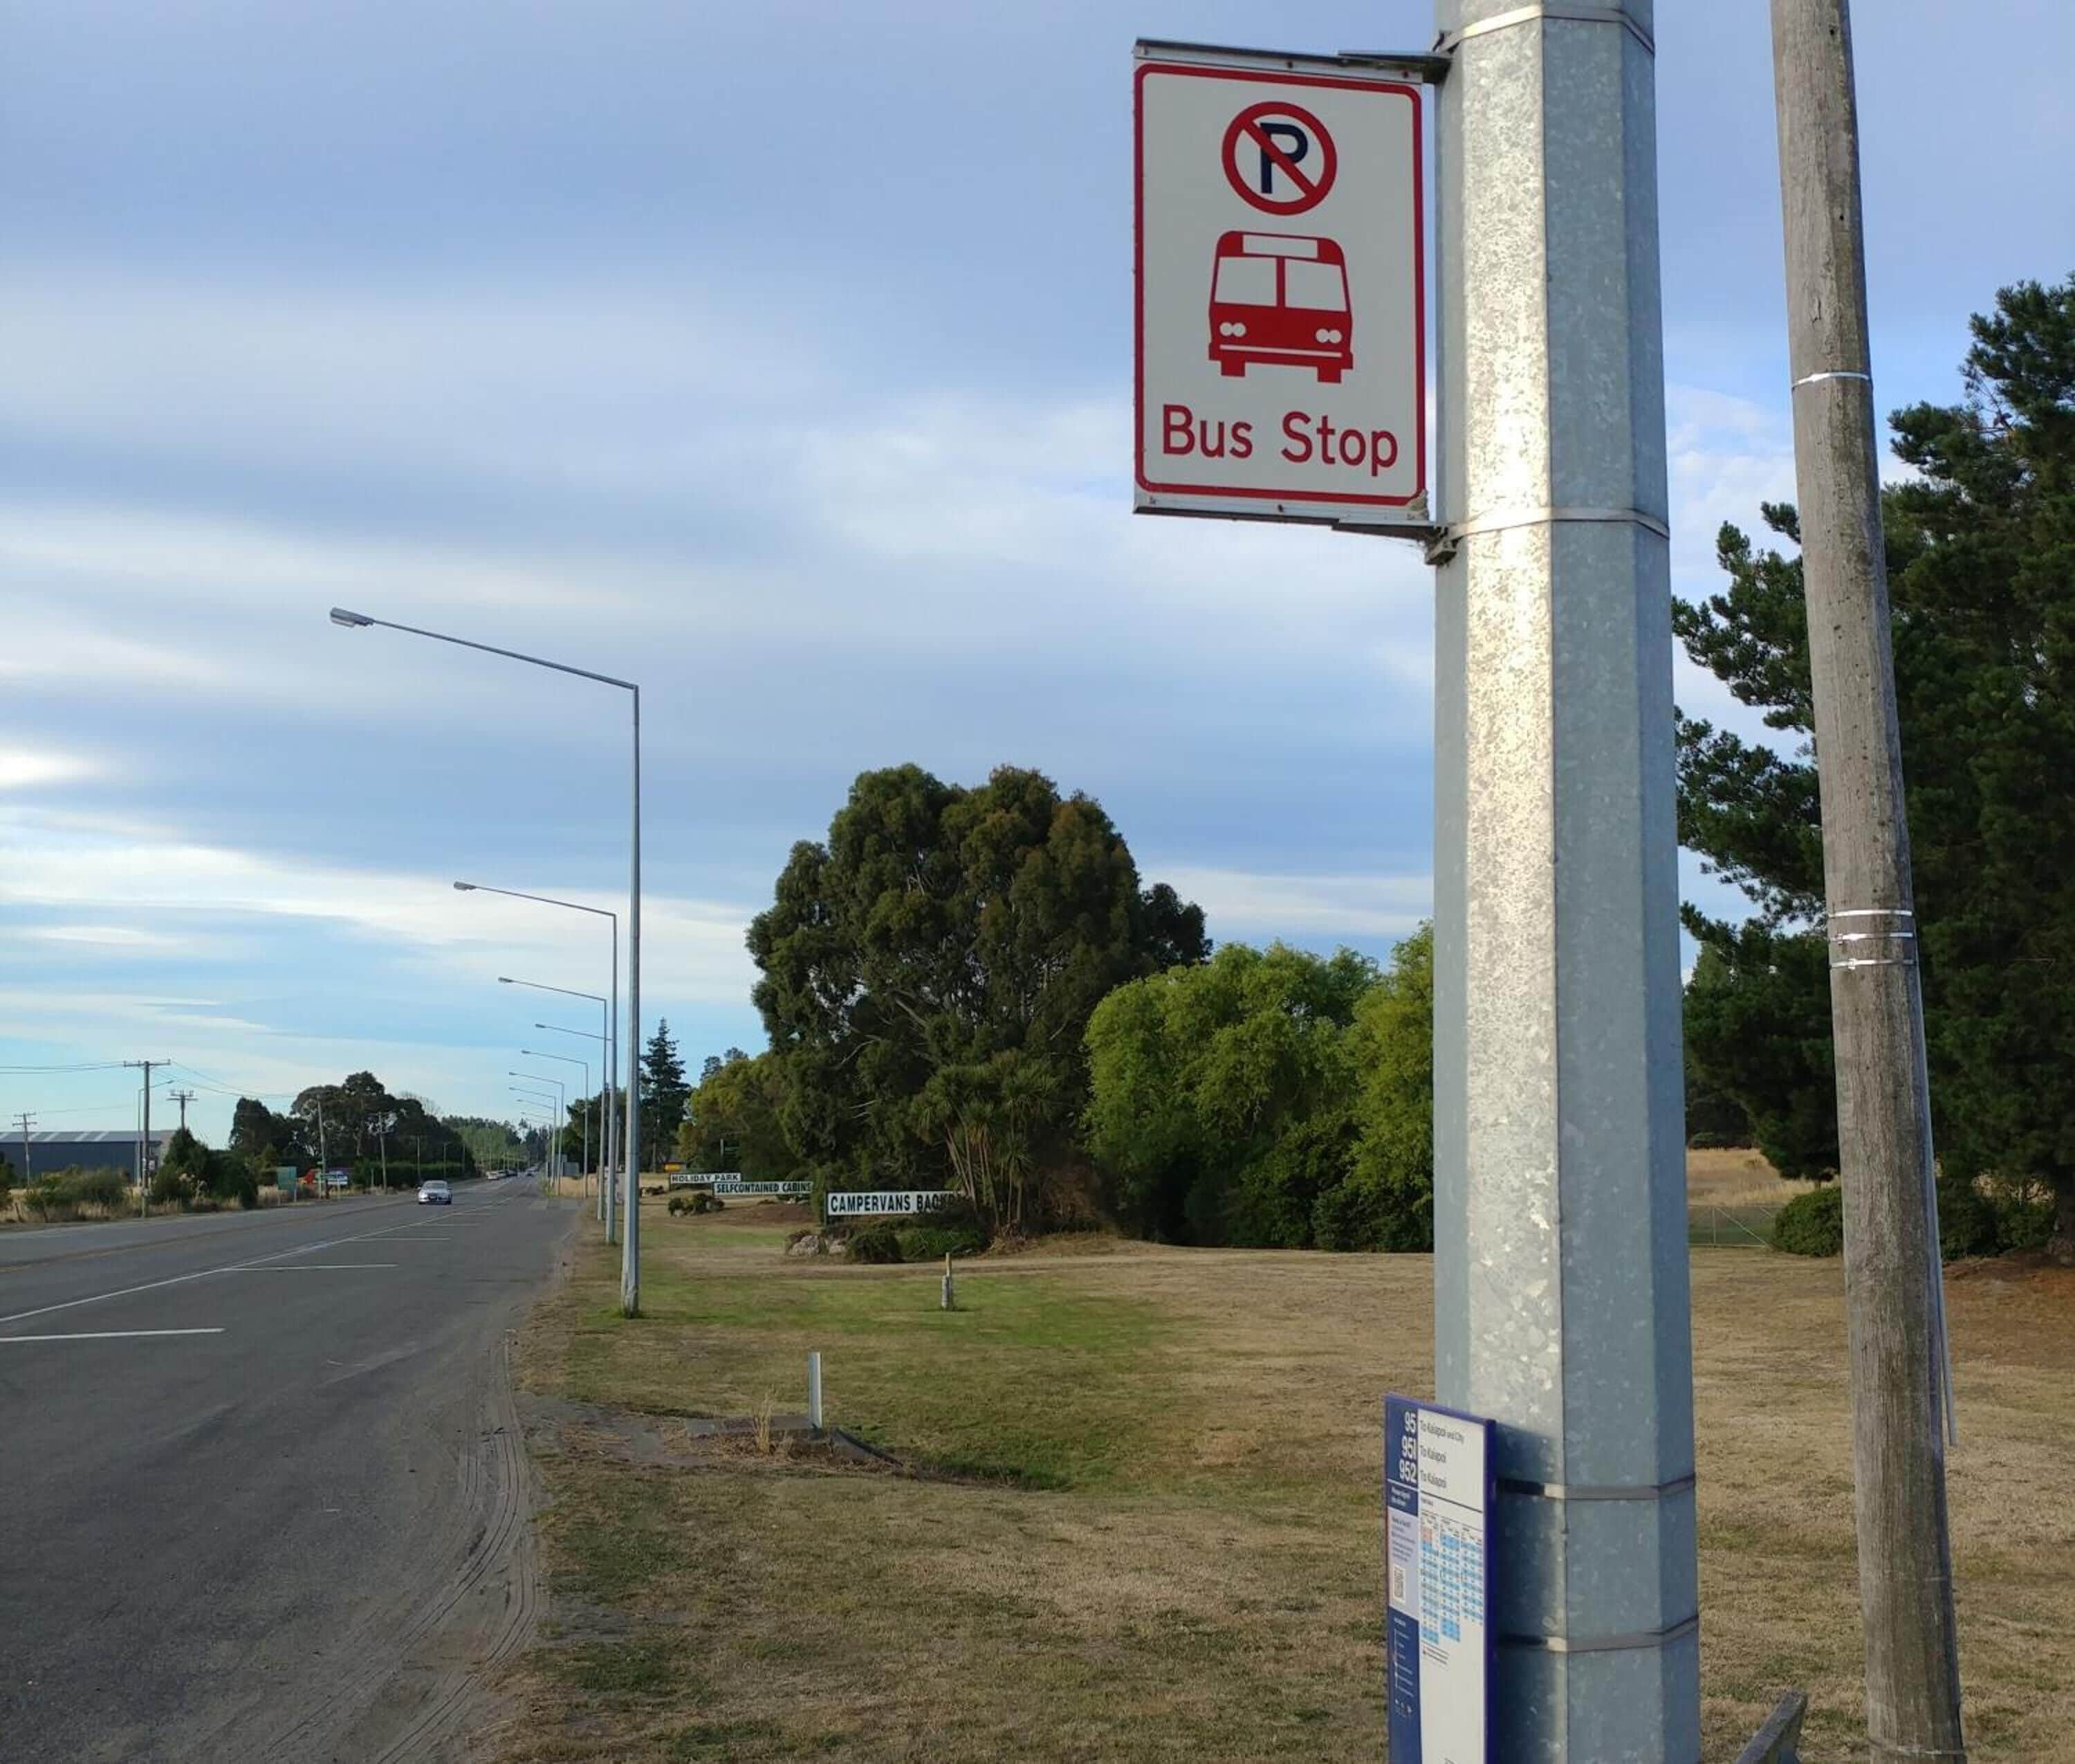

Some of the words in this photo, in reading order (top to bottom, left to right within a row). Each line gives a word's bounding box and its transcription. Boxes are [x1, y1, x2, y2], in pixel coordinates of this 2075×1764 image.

[1260, 122, 1309, 194] P
[1162, 403, 1253, 459] Bus
[1282, 410, 1399, 476] Stop
[672, 1174, 712, 1182] HOLIDAY
[717, 1183, 779, 1193] SELFCONTAINED
[831, 1195, 911, 1212] CAMPERVANS
[1405, 1411, 1416, 1433] 95
[1401, 1435, 1417, 1460] 951
[1399, 1459, 1417, 1483] 952
